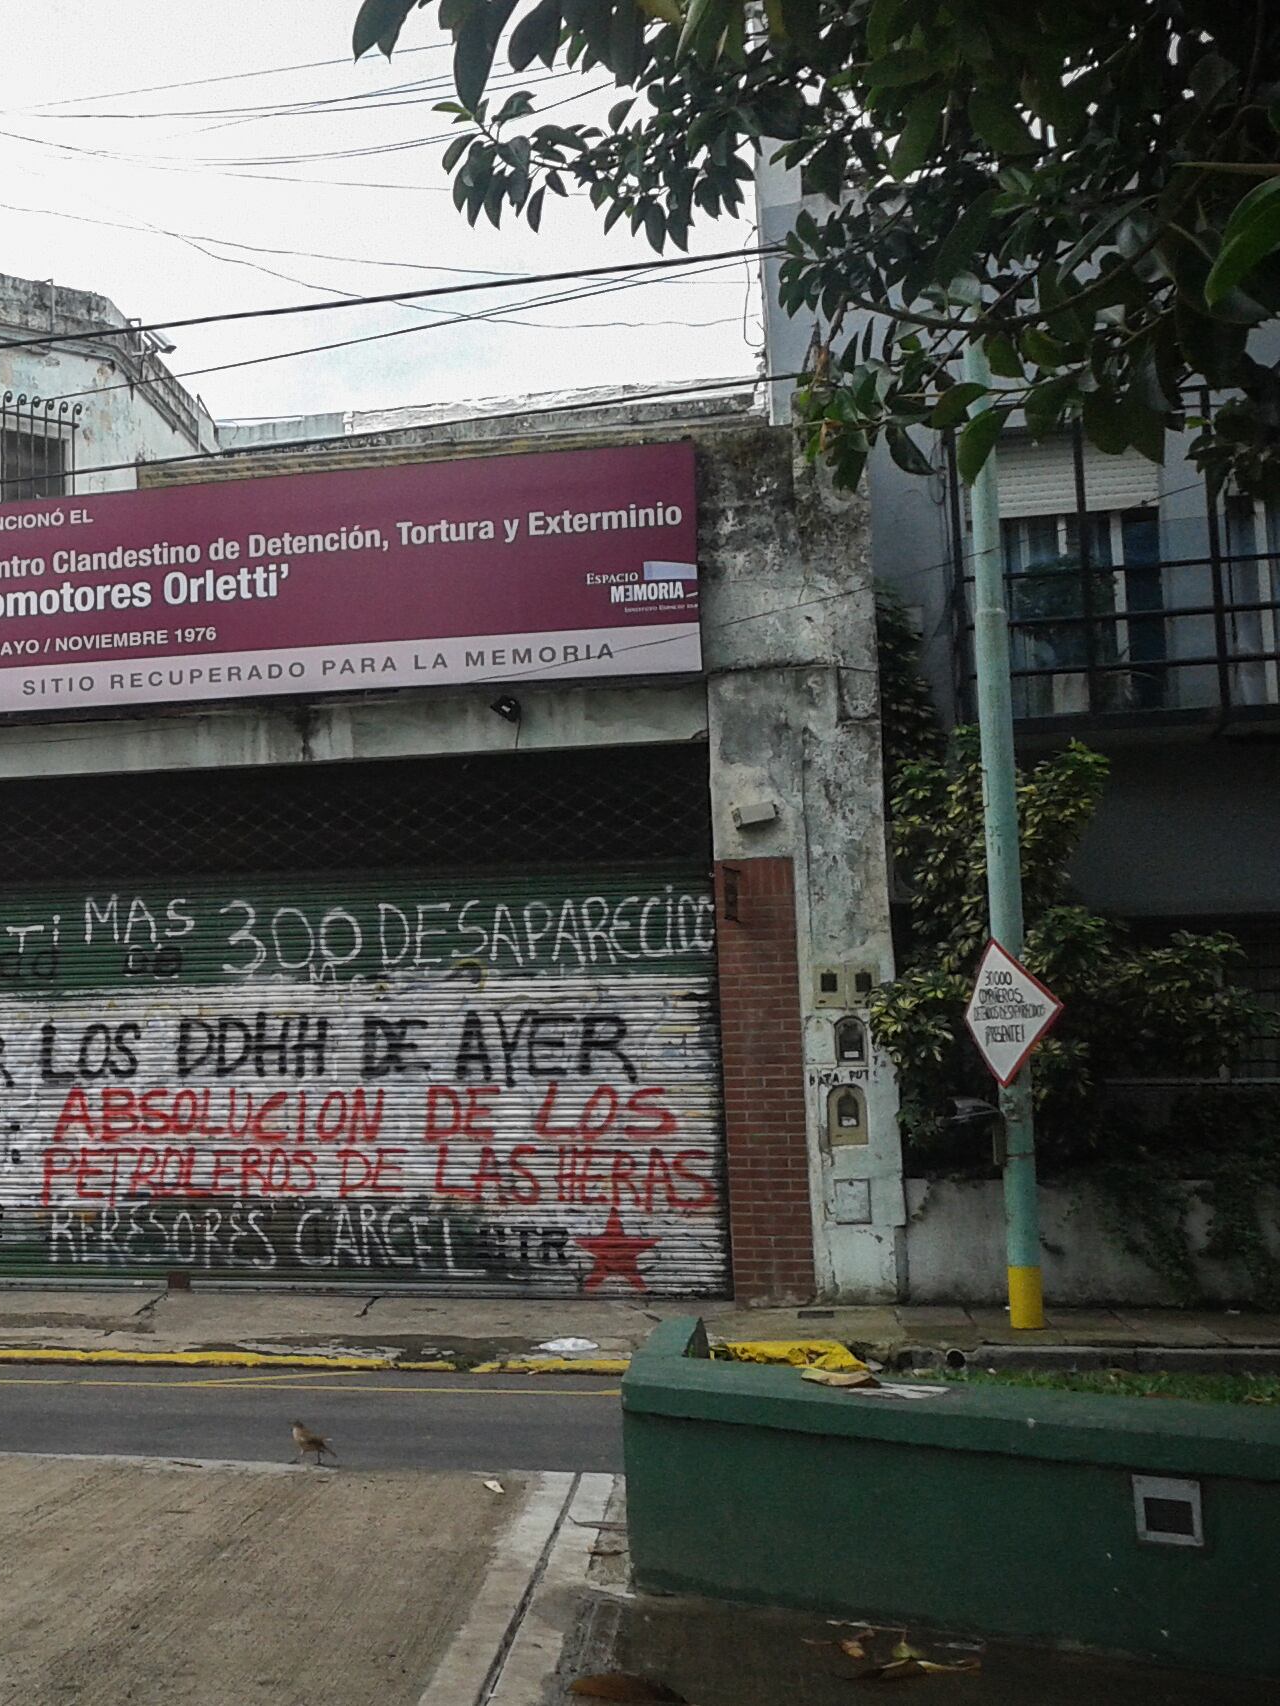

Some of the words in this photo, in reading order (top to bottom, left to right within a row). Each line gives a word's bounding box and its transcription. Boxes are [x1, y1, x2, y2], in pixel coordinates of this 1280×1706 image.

[52, 542, 201, 574] Clandestino
[208, 537, 241, 561] de
[248, 524, 389, 559] Detención,
[395, 519, 495, 546] Tortura
[503, 518, 520, 543] y
[528, 501, 682, 536] Exterminio
[69, 508, 94, 525] EL
[22, 676, 95, 696] SITIO
[110, 661, 306, 690] RECUPERADO
[322, 655, 397, 677] PARA
[413, 651, 448, 671] LA
[464, 642, 615, 668] MEMORIA
[43, 638, 52, 653] /
[55, 629, 169, 652] NOVIEMBRE
[174, 626, 217, 643] 1976
[84, 893, 195, 945] MAS
[40, 1021, 142, 1079] LOS
[177, 1011, 327, 1079] DDHH
[360, 1015, 431, 1079] DE
[455, 1009, 638, 1087] AYER
[52, 1086, 385, 1143] ABSOLUCION
[426, 1085, 500, 1141] DE
[534, 1080, 678, 1141] LOS
[40, 1146, 318, 1208] PETROLEROS
[336, 1147, 409, 1197] DE
[434, 1145, 542, 1205] LAS
[555, 1147, 717, 1212] HERAS
[295, 1203, 488, 1276] CARCEL
